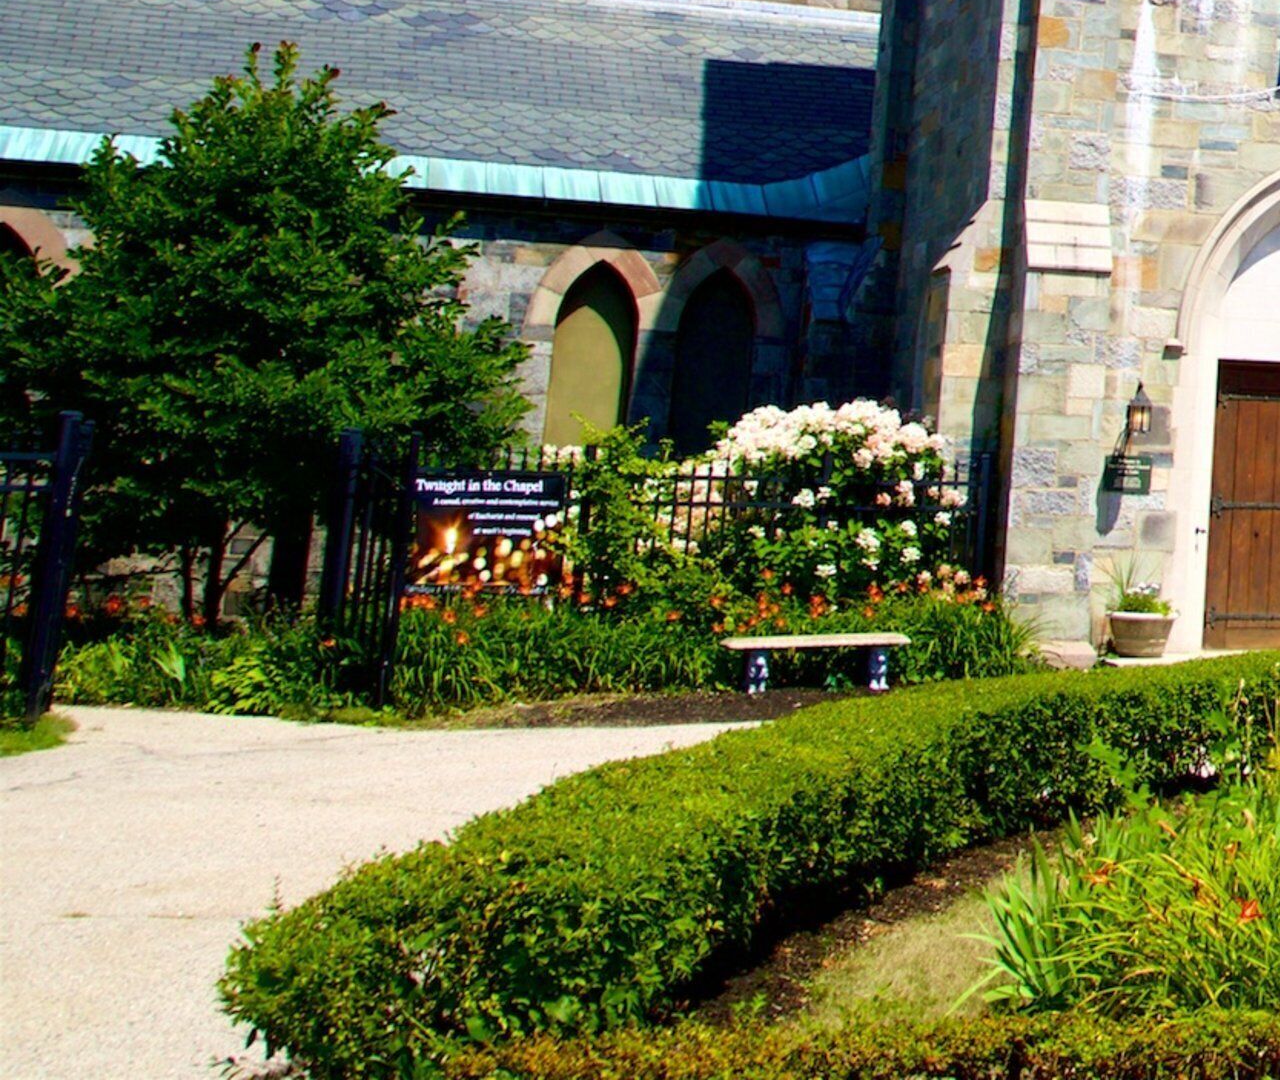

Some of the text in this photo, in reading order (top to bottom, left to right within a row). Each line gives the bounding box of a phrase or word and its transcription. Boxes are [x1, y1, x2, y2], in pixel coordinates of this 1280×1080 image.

[415, 478, 543, 495] Twilight in the Chapel
